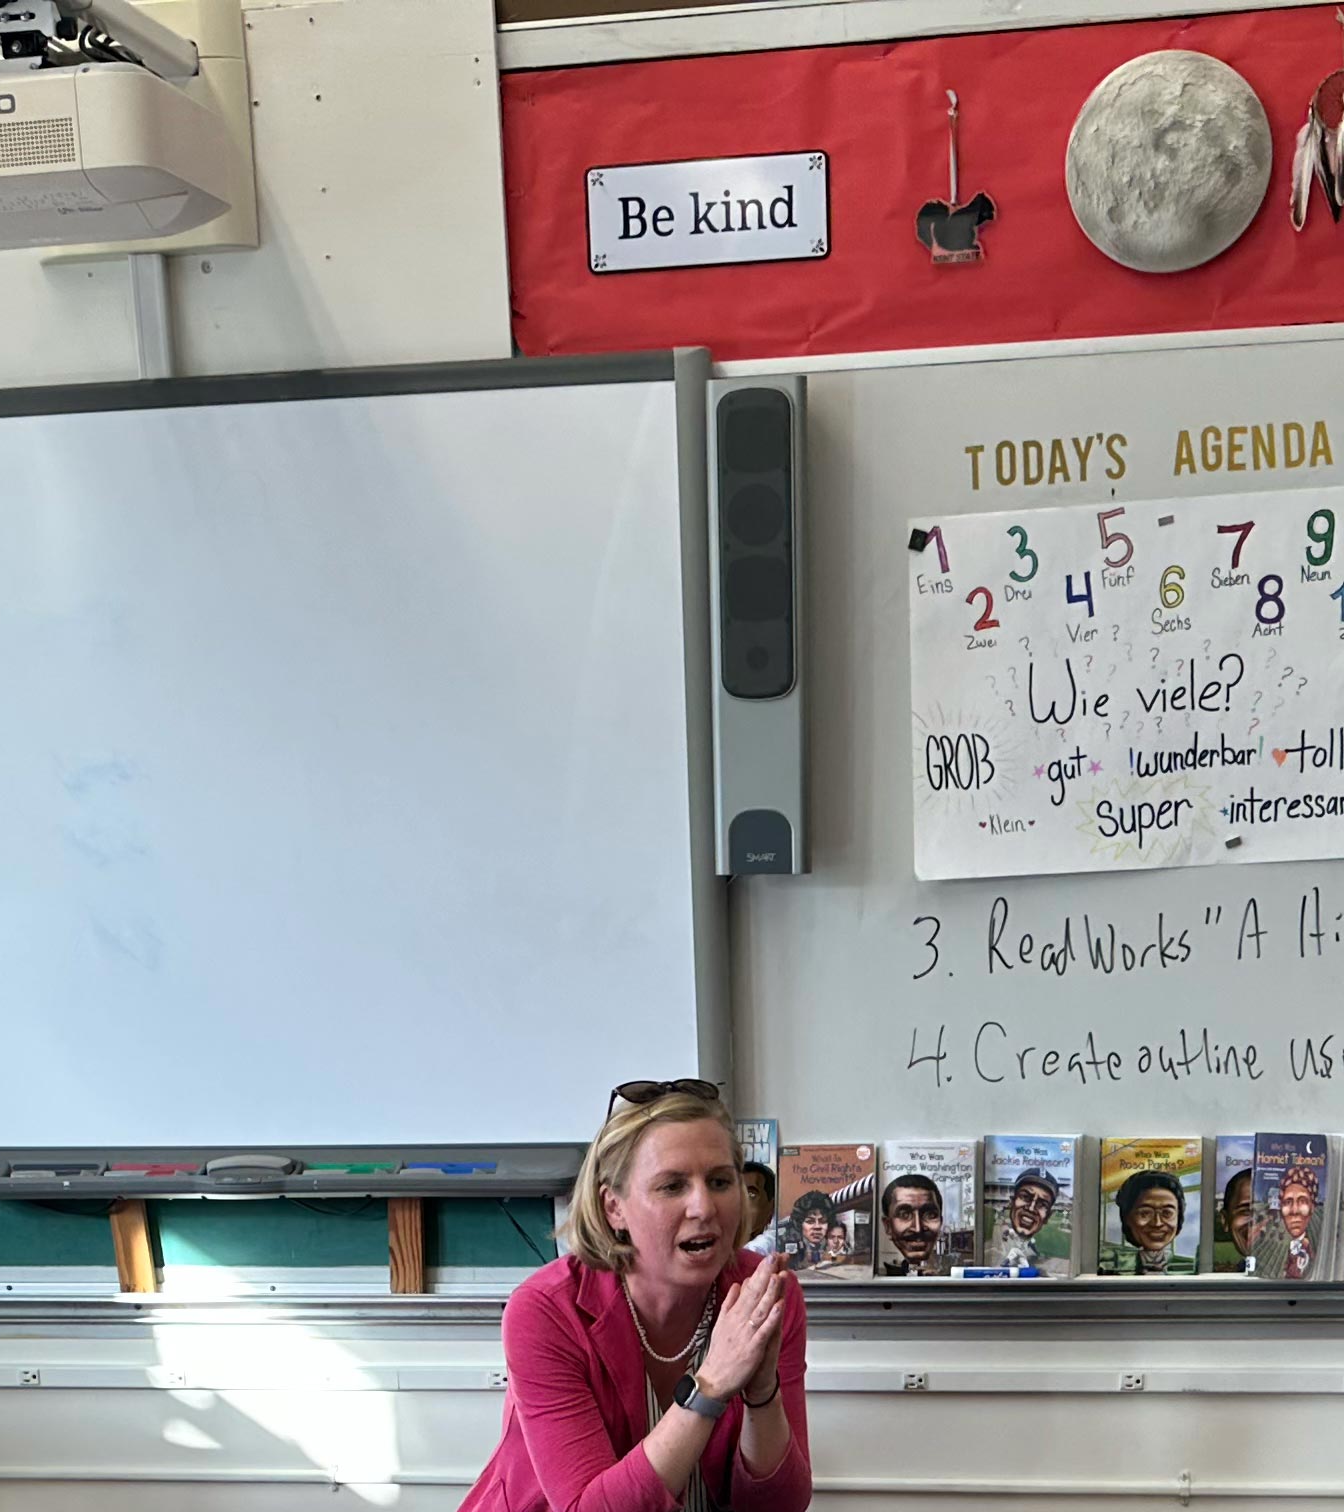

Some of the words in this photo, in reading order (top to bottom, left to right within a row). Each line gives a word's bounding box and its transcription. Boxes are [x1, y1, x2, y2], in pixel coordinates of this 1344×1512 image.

[618, 196, 675, 240] Be
[689, 186, 797, 236] kind
[965, 434, 1127, 489] TODAY'S
[1174, 421, 1333, 476] AGENDA
[1007, 526, 1038, 582] 3
[1098, 507, 1133, 568] 5
[1217, 521, 1255, 569] 7
[1306, 509, 1335, 566] 9
[916, 574, 953, 594] Eins
[1102, 567, 1134, 589] Fünf
[1301, 565, 1331, 583] Neun
[966, 586, 1000, 631] 2
[1066, 571, 1094, 617] 4
[1160, 565, 1185, 608] 6
[1255, 574, 1285, 624] 8
[1066, 624, 1097, 643] Vier
[1152, 608, 1191, 634] Sechs
[1252, 622, 1284, 638] Acht
[1029, 658, 1109, 724] Wie
[1136, 653, 1244, 712] viele?
[1047, 746, 1087, 806] gut
[1285, 727, 1344, 773] toll
[912, 915, 954, 980] 3.
[907, 1026, 953, 1088] 4.
[975, 1021, 1122, 1084] Create
[1138, 1028, 1263, 1083] outline
[883, 1162, 918, 1174] George
[919, 1162, 972, 1174] Washington
[991, 1155, 1021, 1167] Jackie
[1022, 1156, 1070, 1167] Robinson?
[1120, 1159, 1146, 1170] Rosa
[1148, 1159, 1184, 1170] Parks?
[1257, 1153, 1289, 1165] Harriet
